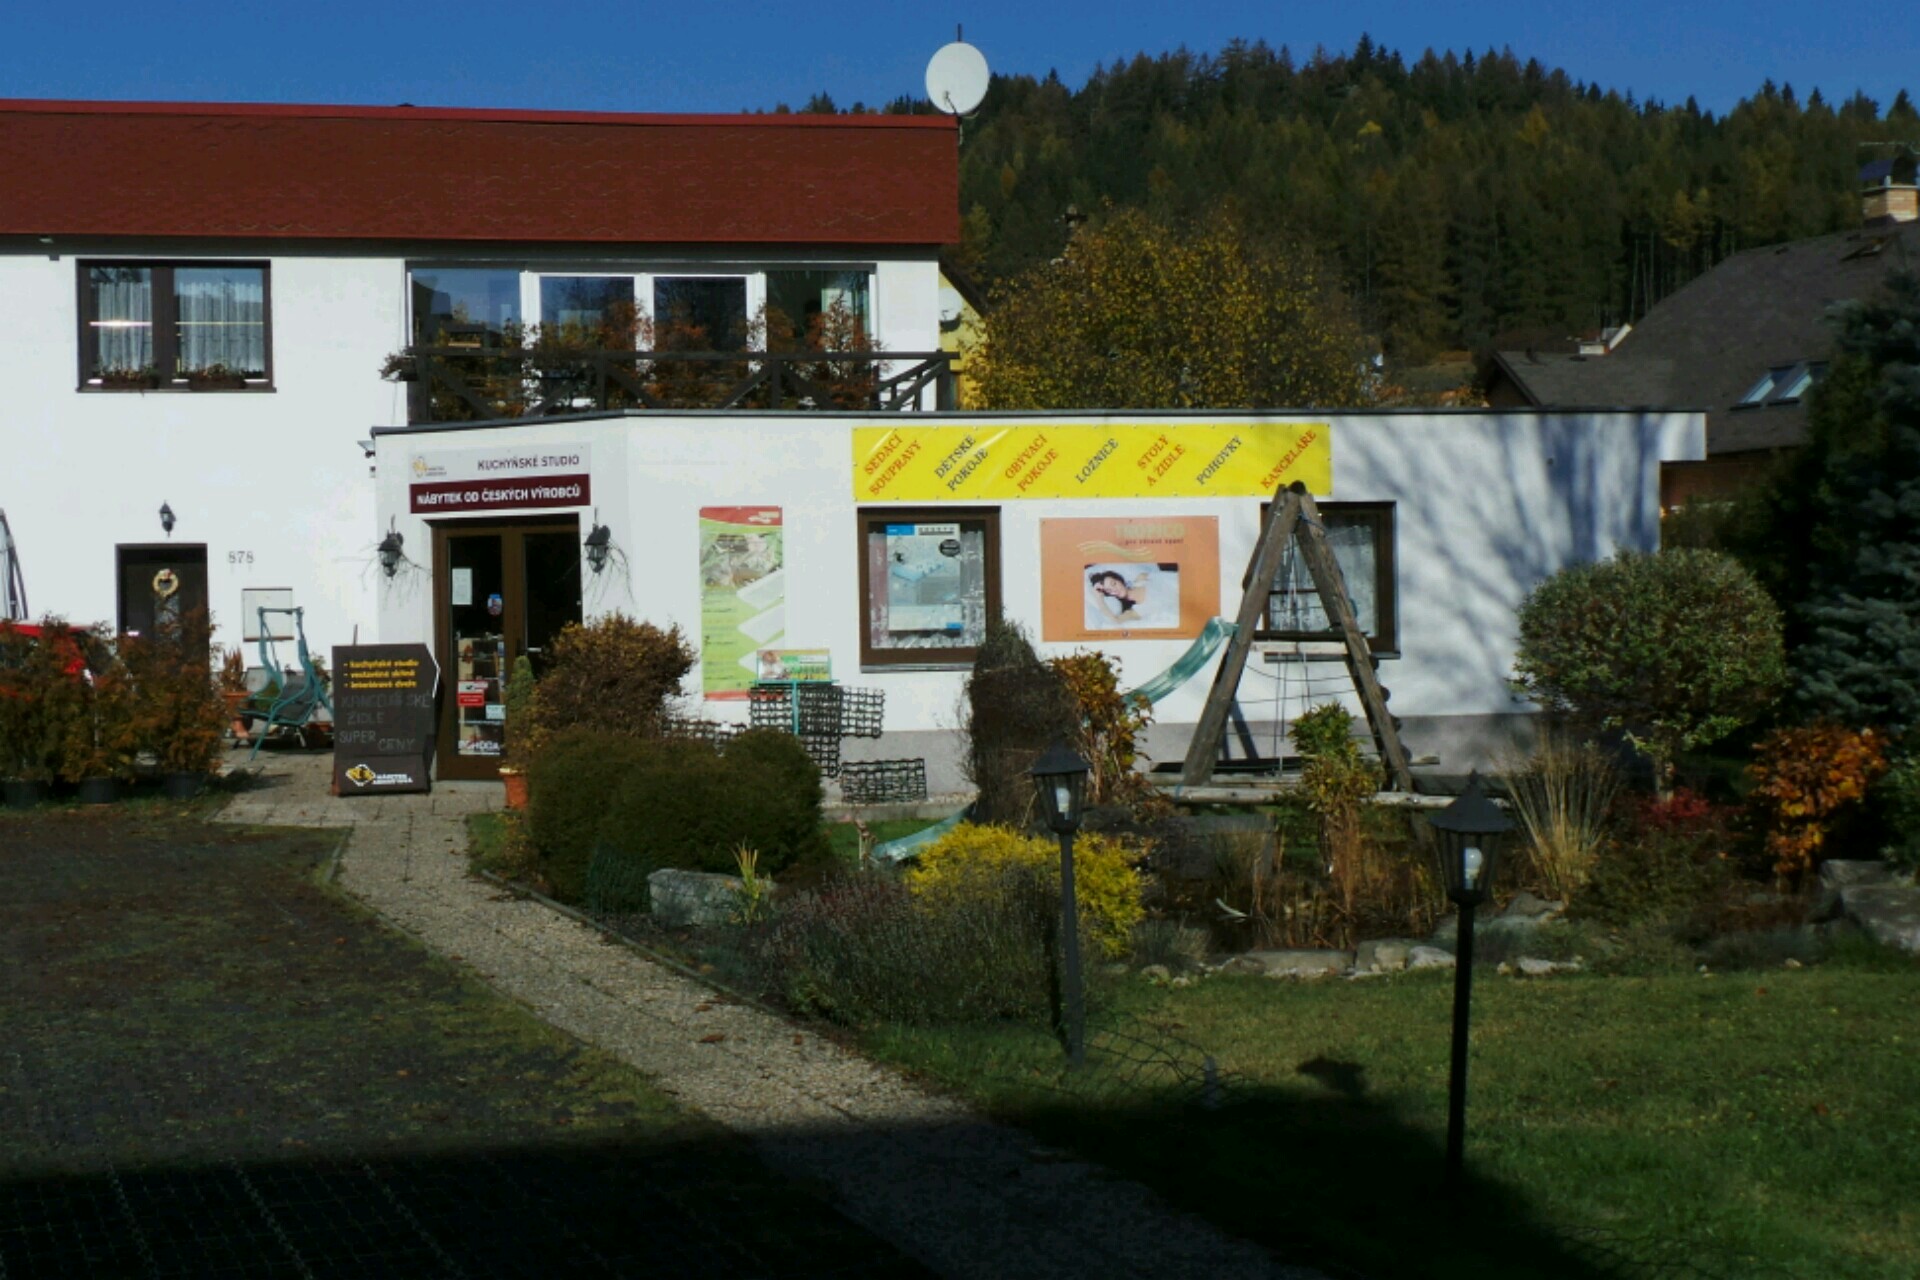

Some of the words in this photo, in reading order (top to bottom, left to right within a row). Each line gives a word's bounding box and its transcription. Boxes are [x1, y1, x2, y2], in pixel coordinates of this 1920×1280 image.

[477, 455, 539, 471] KUCHYŇSKÉ
[541, 454, 580, 468] STUDIO
[868, 439, 921, 496] SOUPRAVY
[946, 448, 989, 492] POKOJE
[1016, 448, 1059, 492] POKOJE
[1074, 438, 1119, 484] LOŽNICE
[1136, 434, 1170, 470] STOLY
[1196, 435, 1243, 486] POHOVKY
[416, 491, 463, 505] NÁBYTEK
[464, 491, 479, 503] OD
[481, 487, 528, 502] ČESKÝCH
[531, 484, 581, 499] VÝROBCŮ
[1146, 475, 1157, 487] A
